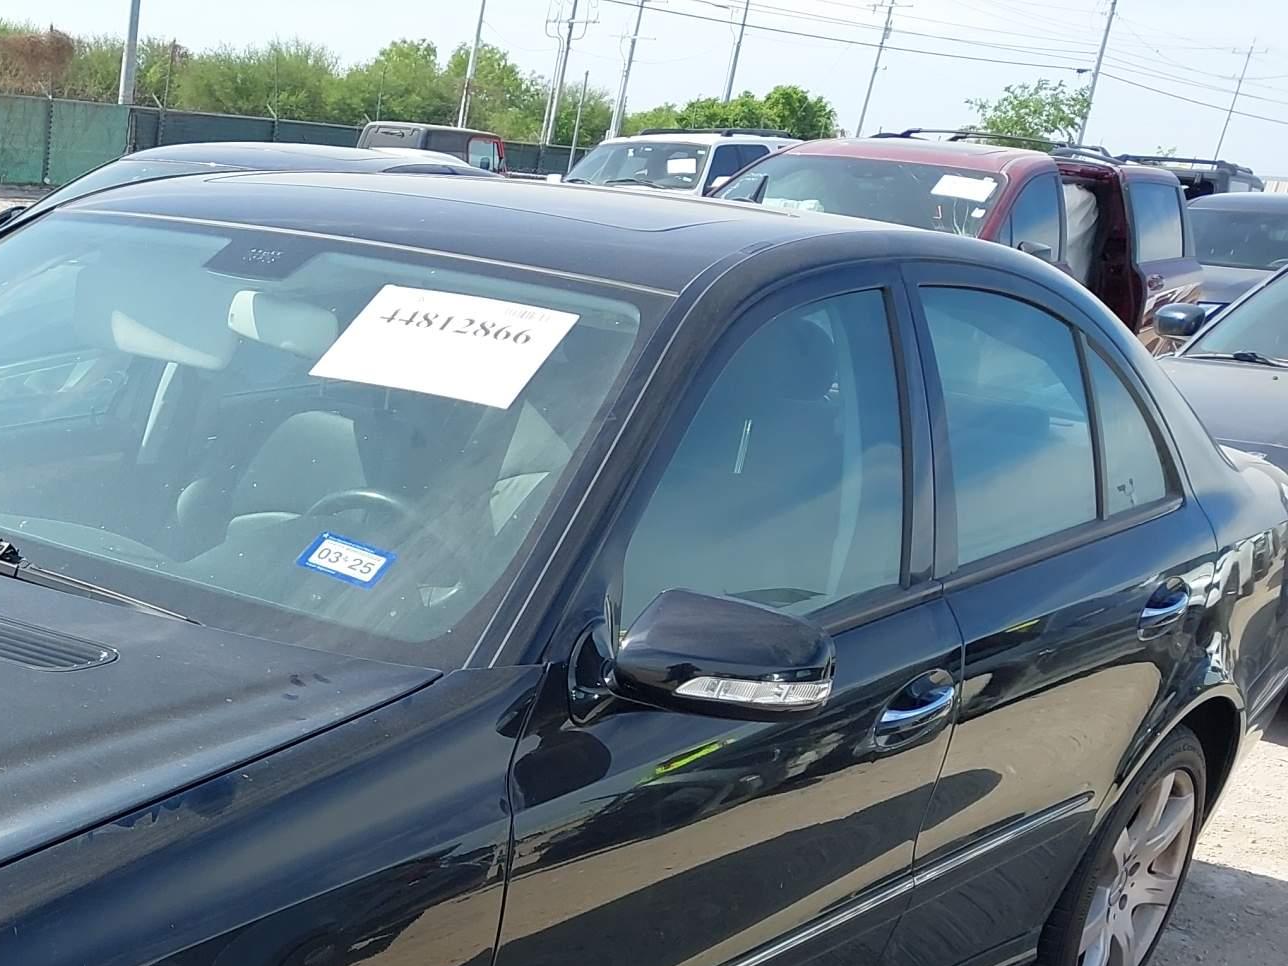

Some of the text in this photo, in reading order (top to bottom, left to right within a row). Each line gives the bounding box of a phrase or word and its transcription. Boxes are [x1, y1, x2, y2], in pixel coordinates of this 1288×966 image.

[380, 308, 533, 345] 44812866
[317, 547, 343, 564] 03
[347, 558, 376, 575] 25
